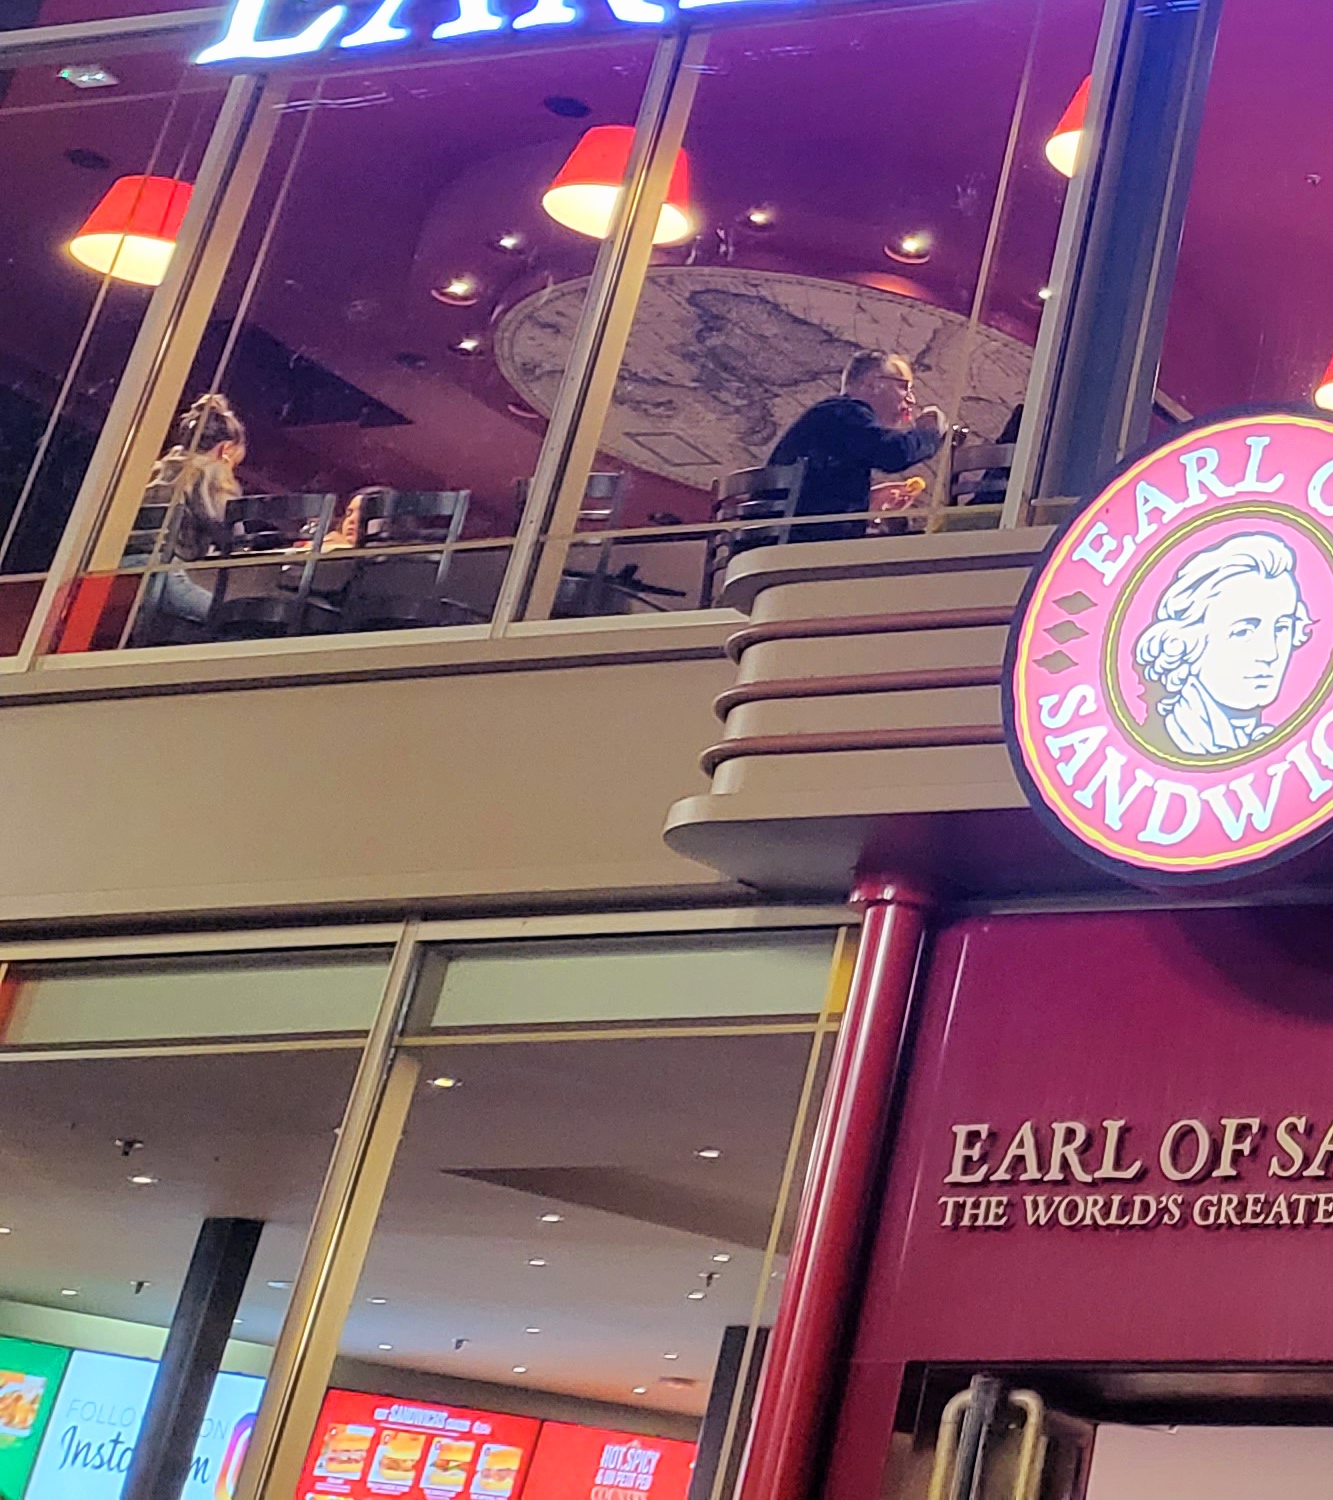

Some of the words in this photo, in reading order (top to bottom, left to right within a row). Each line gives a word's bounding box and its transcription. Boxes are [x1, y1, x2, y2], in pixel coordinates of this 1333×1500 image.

[1072, 436, 1285, 586] EARL
[944, 1119, 1142, 1183] EARL
[1160, 1117, 1260, 1181] OF
[939, 1196, 1008, 1226] THE
[1023, 1194, 1183, 1226] WORLD'S
[66, 1399, 142, 1429] FOLLO
[58, 1425, 209, 1484] Instam
